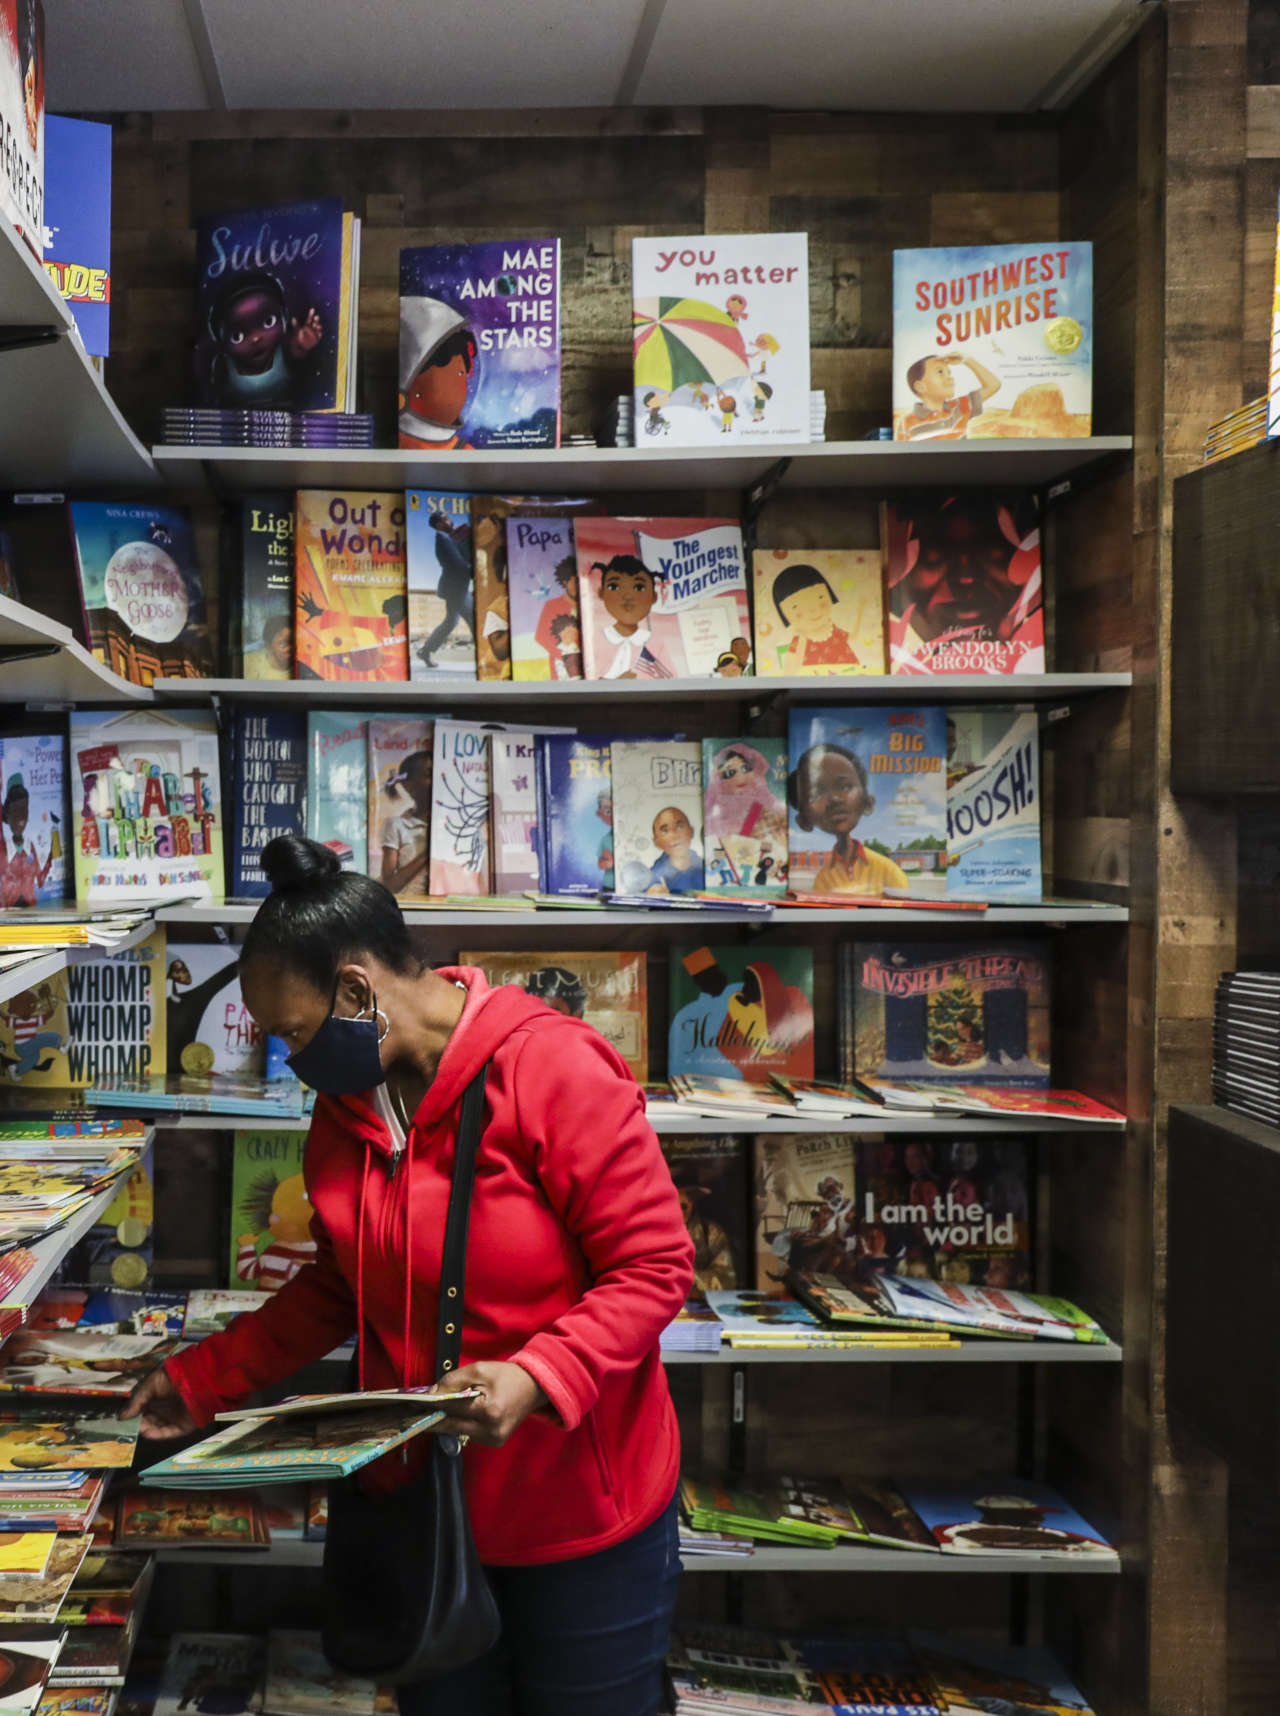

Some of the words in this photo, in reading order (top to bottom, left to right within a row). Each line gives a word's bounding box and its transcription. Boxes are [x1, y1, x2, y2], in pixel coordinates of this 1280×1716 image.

[208, 223, 322, 278] Sulwe
[502, 248, 553, 271] MAE
[655, 248, 716, 272] you
[694, 265, 799, 287] matter
[915, 251, 1071, 312] SOUTHWEST
[507, 302, 552, 323] THE
[935, 288, 1058, 347] SUNRISE
[480, 327, 553, 352] STARS
[329, 498, 381, 528] Out
[517, 523, 562, 552] Papa
[673, 539, 699, 559] The
[658, 546, 740, 580] Youngest
[673, 563, 741, 600] Marcher
[931, 655, 1008, 670] BROOKS
[244, 718, 268, 738] THE
[244, 740, 291, 761] WOMEN
[243, 762, 271, 782] WHO
[243, 784, 296, 804] CAUGHT
[243, 805, 267, 825] THE
[863, 959, 951, 998] INVISIBLE
[247, 1137, 290, 1162] CRAZY
[865, 1192, 874, 1223] I
[881, 1203, 927, 1224] am
[933, 1193, 985, 1223] the
[924, 1213, 1014, 1247] world
